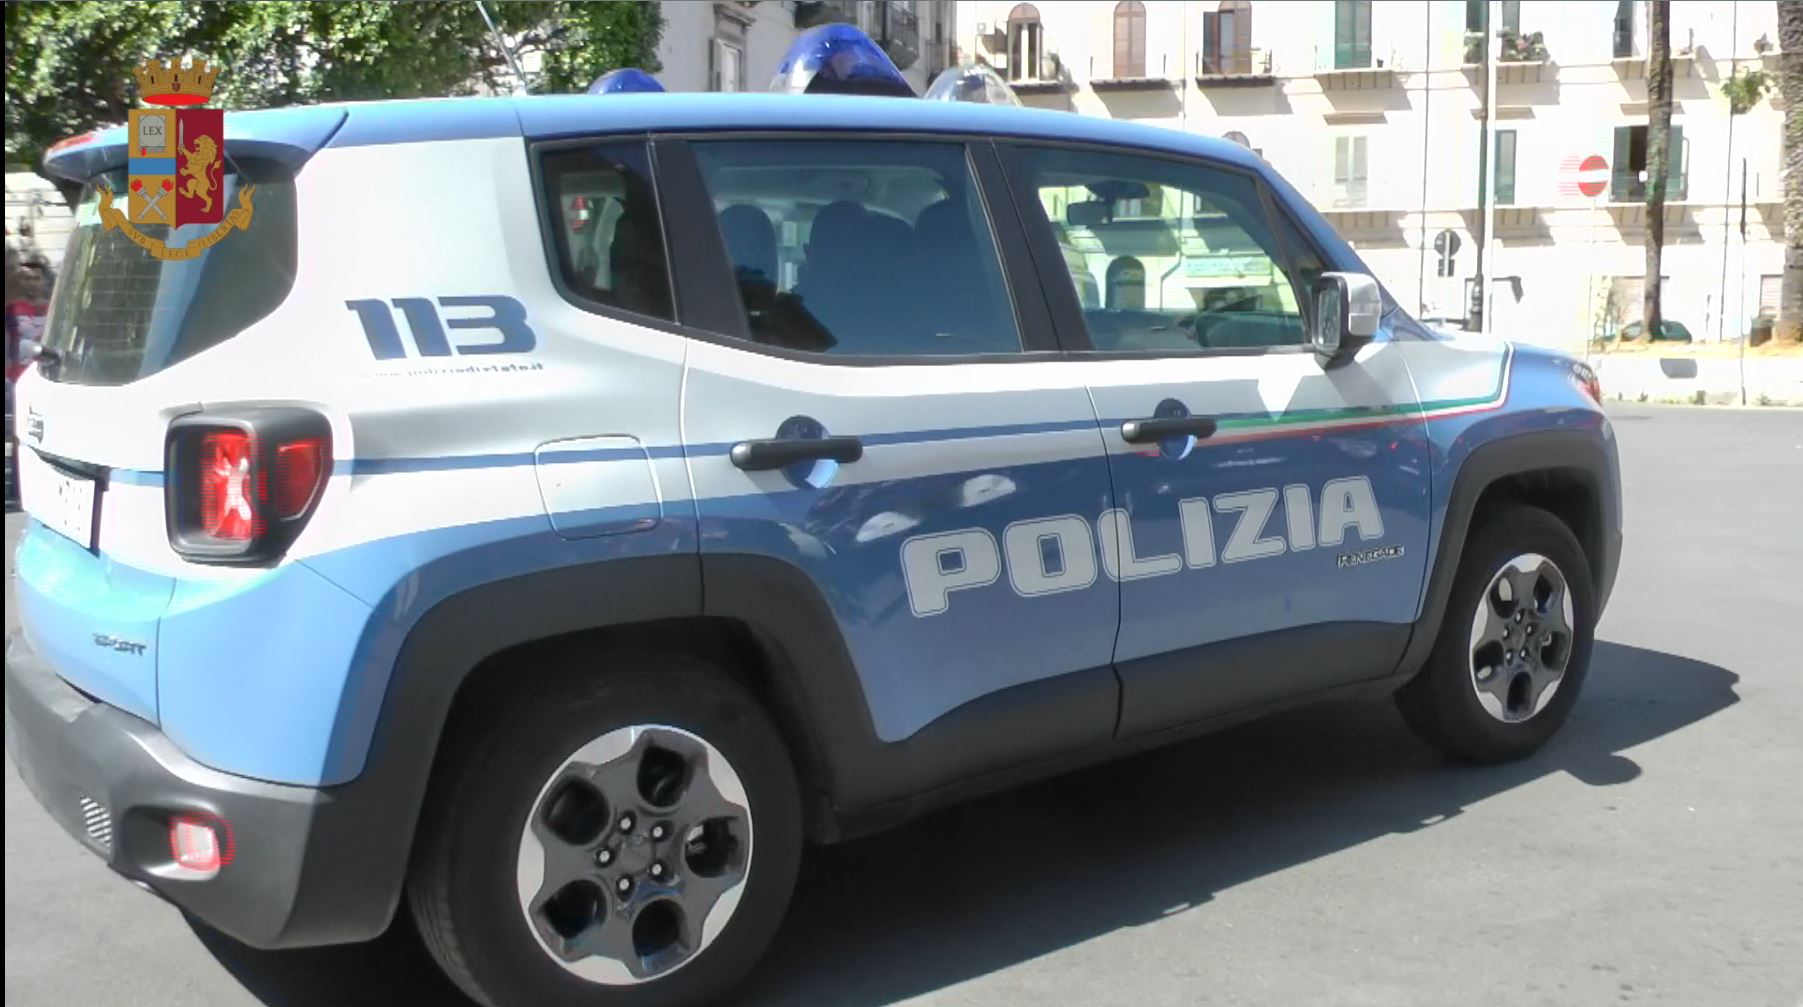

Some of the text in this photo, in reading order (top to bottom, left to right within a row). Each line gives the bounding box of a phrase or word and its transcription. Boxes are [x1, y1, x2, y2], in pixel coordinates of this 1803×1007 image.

[344, 294, 537, 361] 113
[900, 475, 1385, 618] POLIZIA
[1337, 545, 1405, 569] RENEGADE
